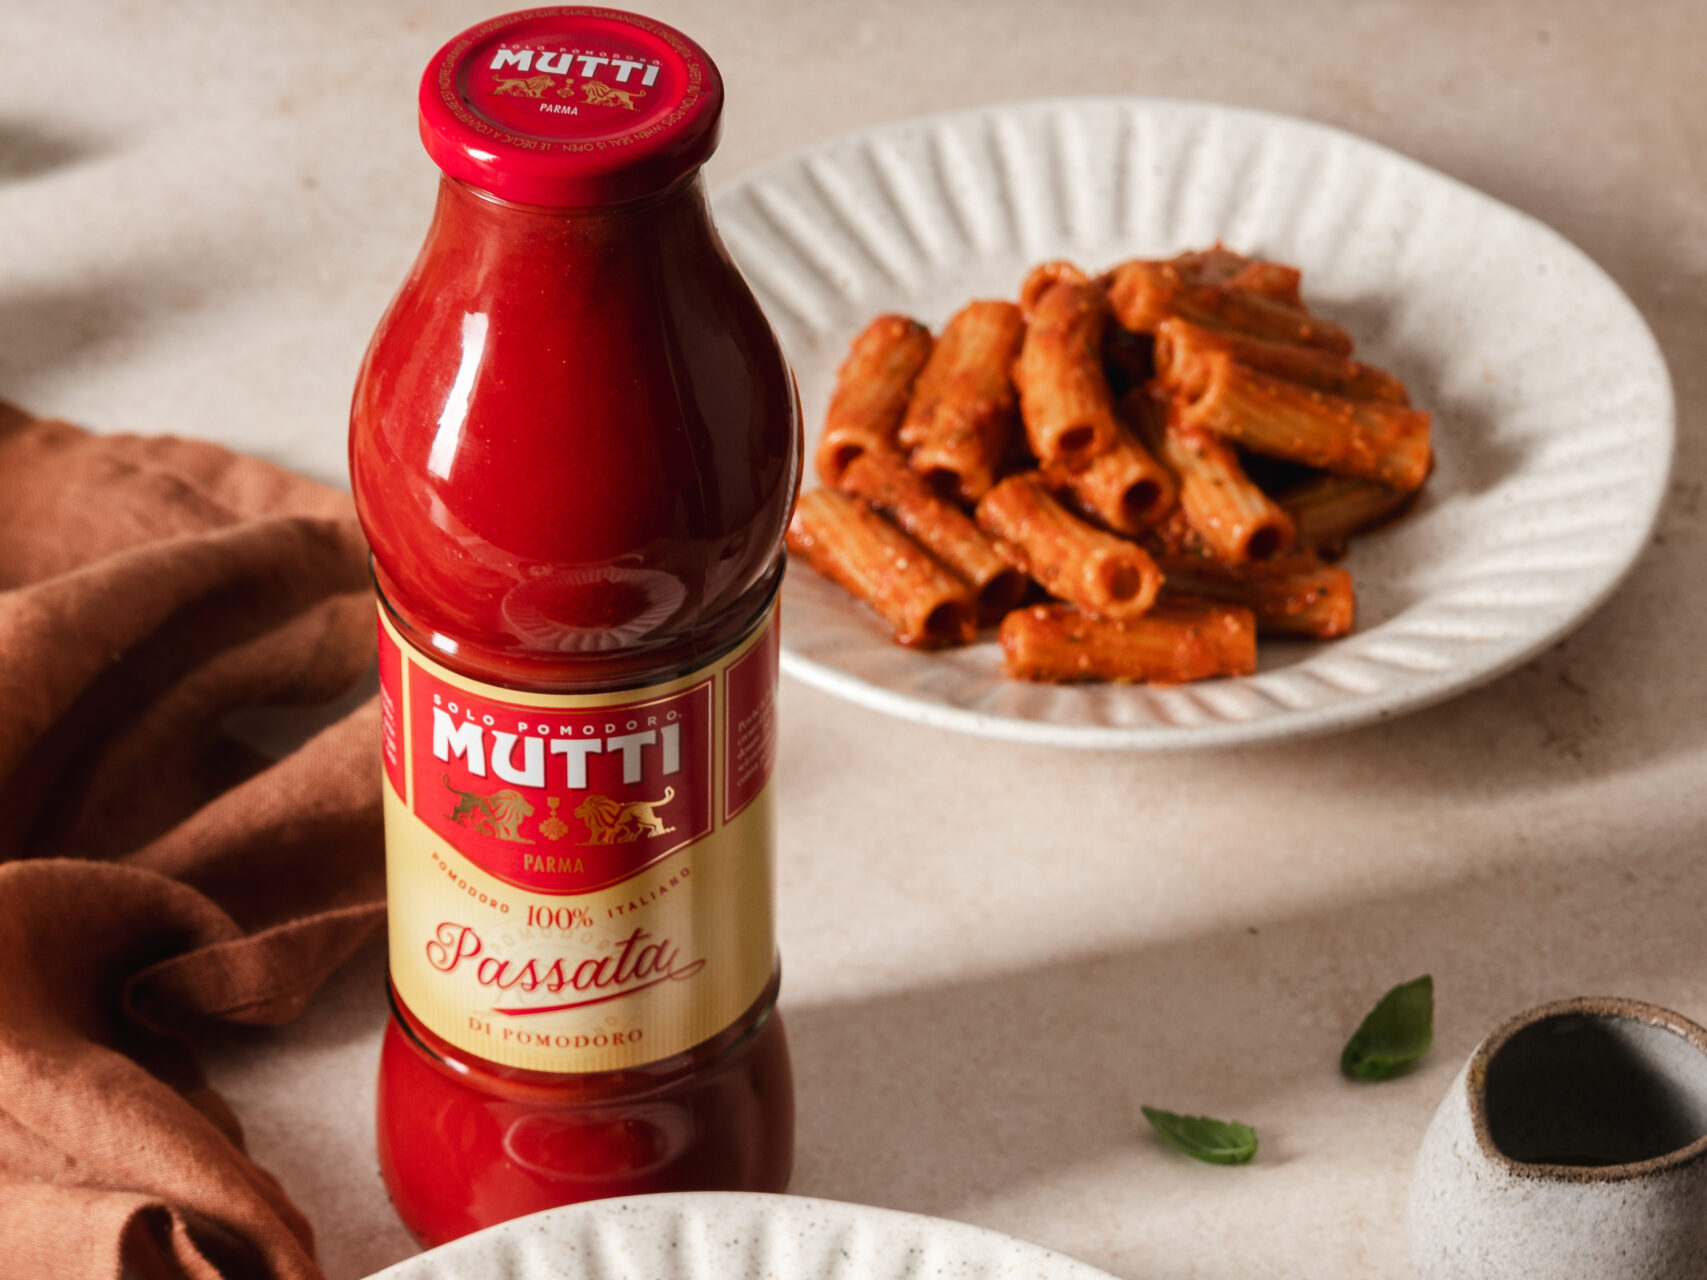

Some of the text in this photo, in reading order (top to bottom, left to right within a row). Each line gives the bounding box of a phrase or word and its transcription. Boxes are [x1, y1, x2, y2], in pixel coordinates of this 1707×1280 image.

[500, 43, 545, 51] SOLO
[490, 49, 660, 87] MUTTI
[539, 103, 578, 116] PARMA
[608, 136, 634, 147] SEAL
[634, 126, 664, 140] WHEN
[539, 142, 551, 151] LE
[562, 143, 594, 152] OPEN
[597, 142, 607, 151] IS
[433, 694, 495, 726] SOLO
[432, 706, 682, 789] MUTTI
[524, 854, 584, 874] PARMA
[431, 852, 692, 930] POMODORO 100% ITALIANO
[426, 922, 707, 994] Passata
[468, 1017, 644, 1049] DI POMODORO
